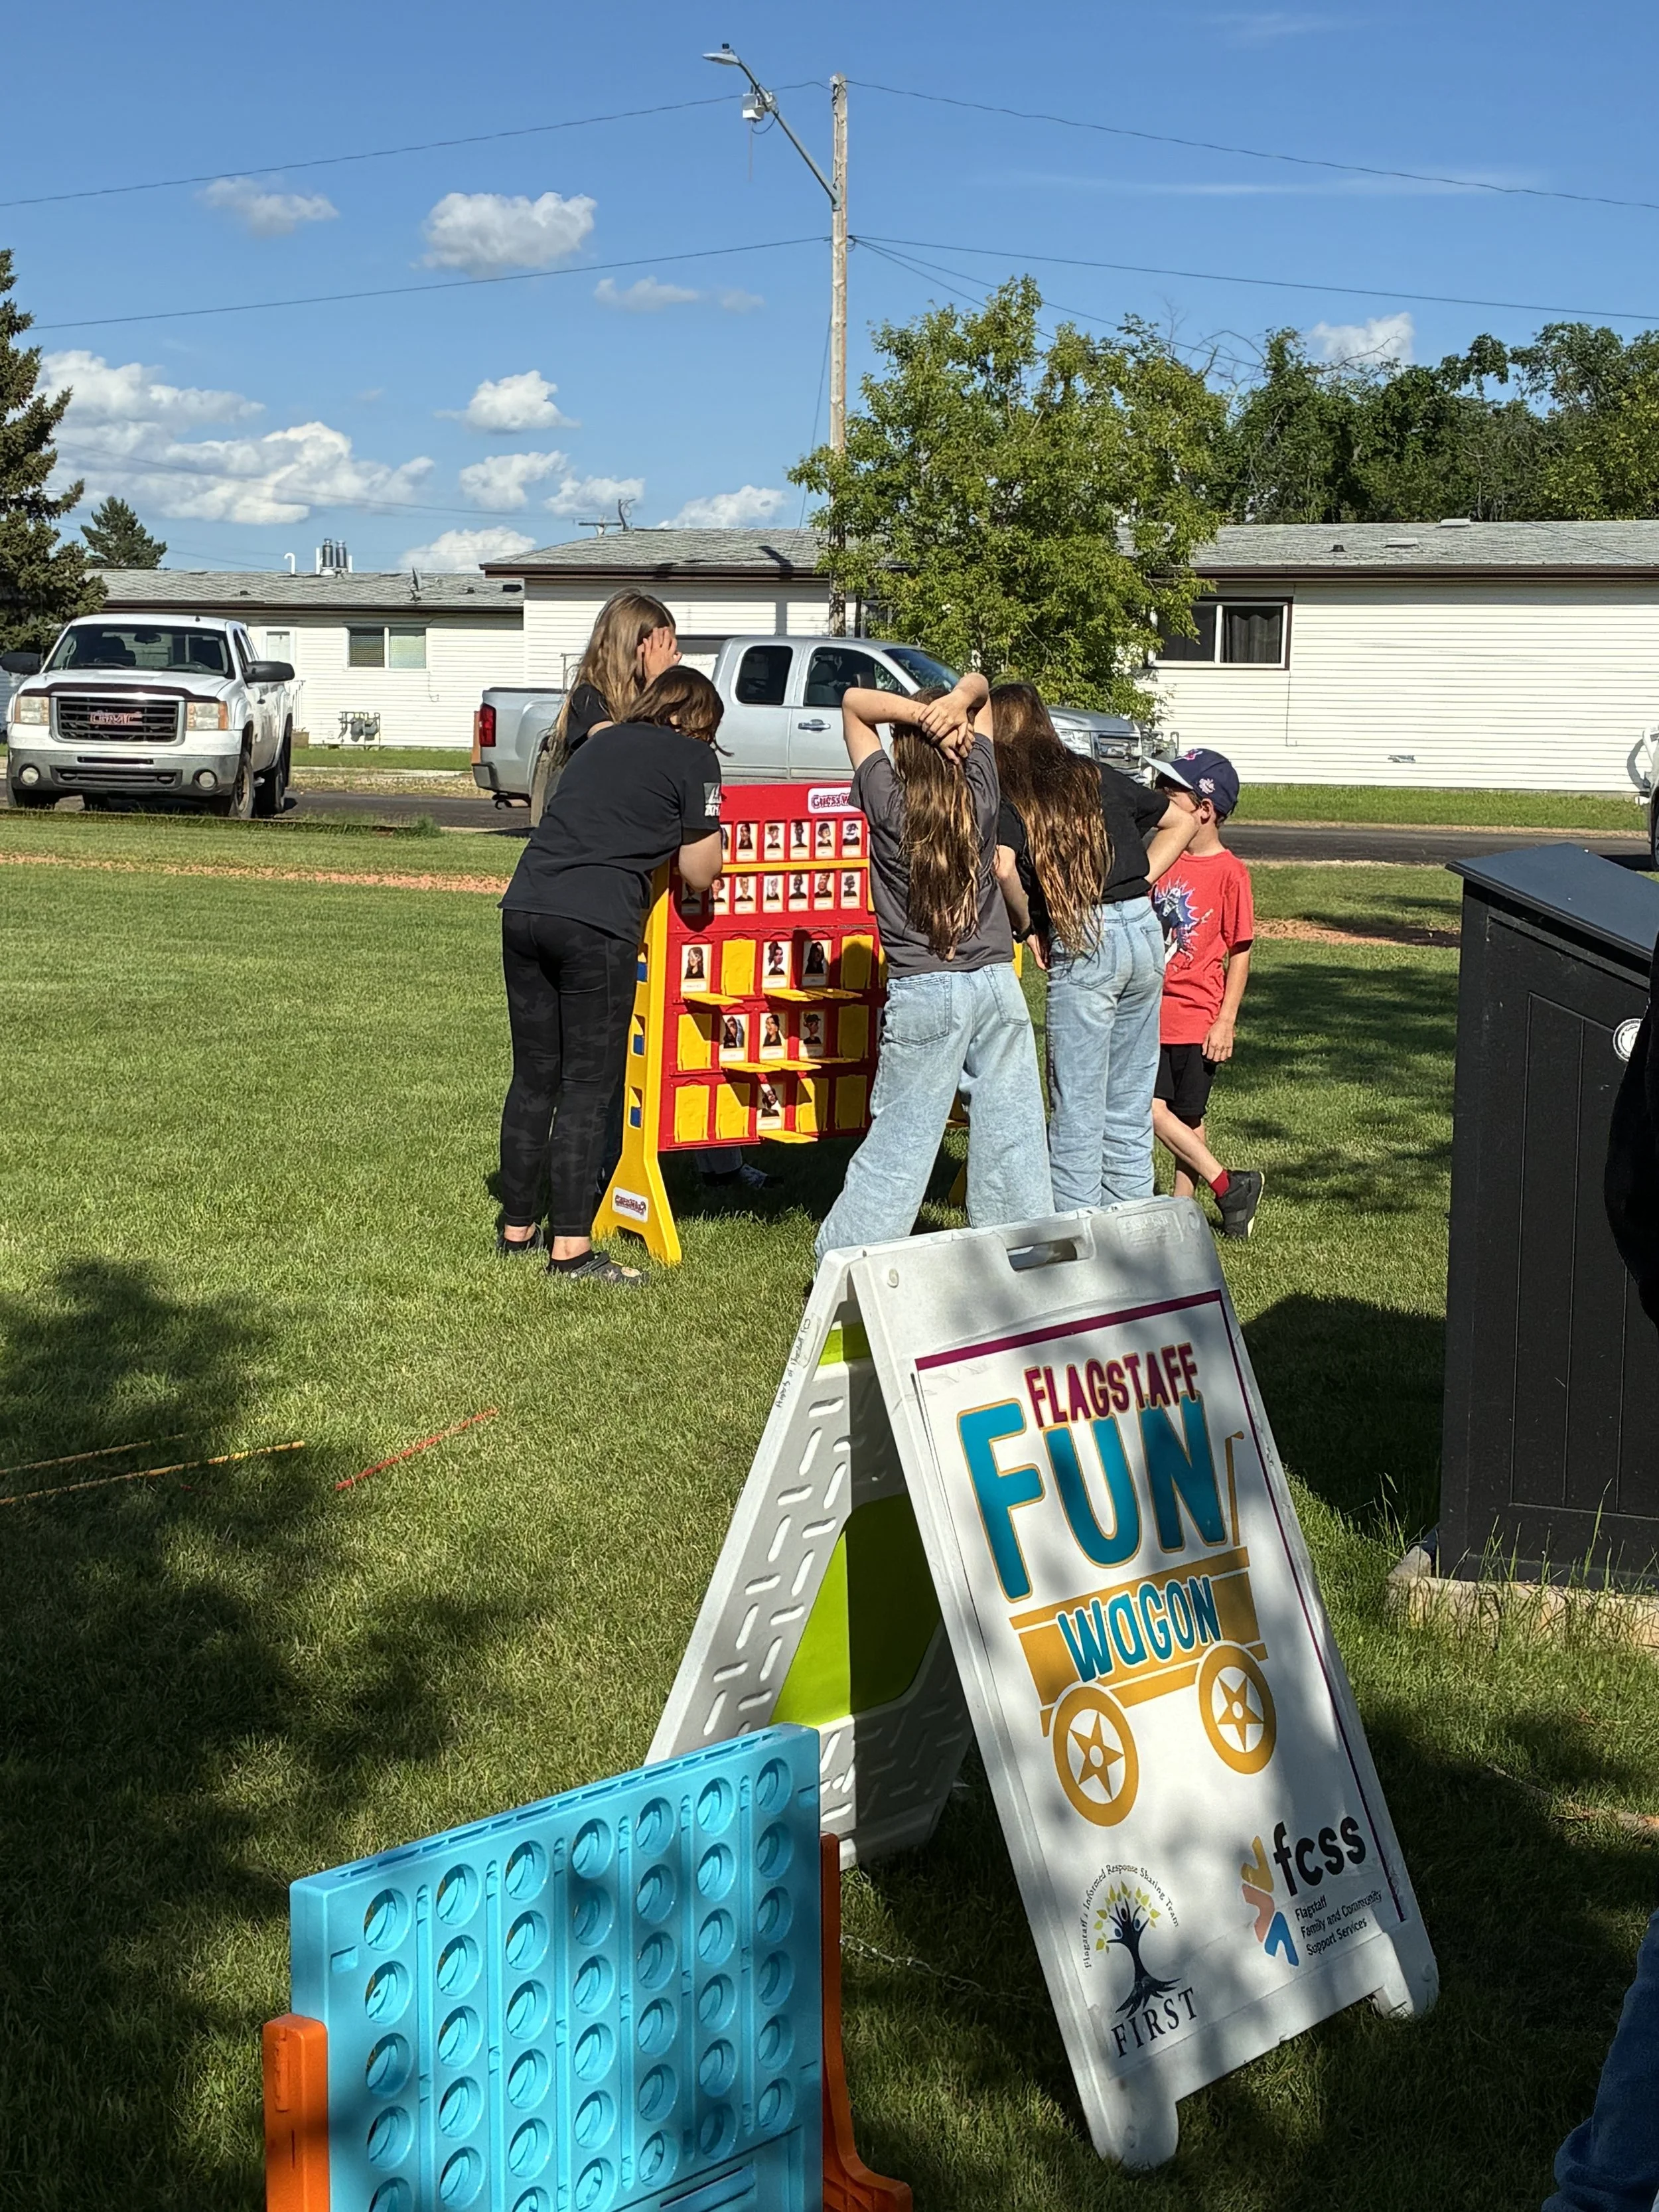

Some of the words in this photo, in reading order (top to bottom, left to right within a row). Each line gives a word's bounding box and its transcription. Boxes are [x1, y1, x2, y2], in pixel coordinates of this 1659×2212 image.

[90, 711, 143, 726] GMC
[1025, 1343, 1199, 1428] FLAGSTAFF
[957, 1391, 1228, 1603] FUN
[1273, 1816, 1366, 1896] fcss
[1083, 1868, 1106, 1910] Informed
[1106, 1864, 1138, 1874] Response
[1140, 1868, 1165, 1901] Sharing
[1165, 1896, 1179, 1927] Team
[1295, 1895, 1327, 1921] Flagstaff
[1301, 1918, 1325, 1939] Family
[1327, 1907, 1342, 1925] and
[1341, 1890, 1382, 1917] Community
[1306, 1932, 1337, 1956] Support
[1336, 1918, 1368, 1941] Services
[1111, 1987, 1199, 2058] FIRST
